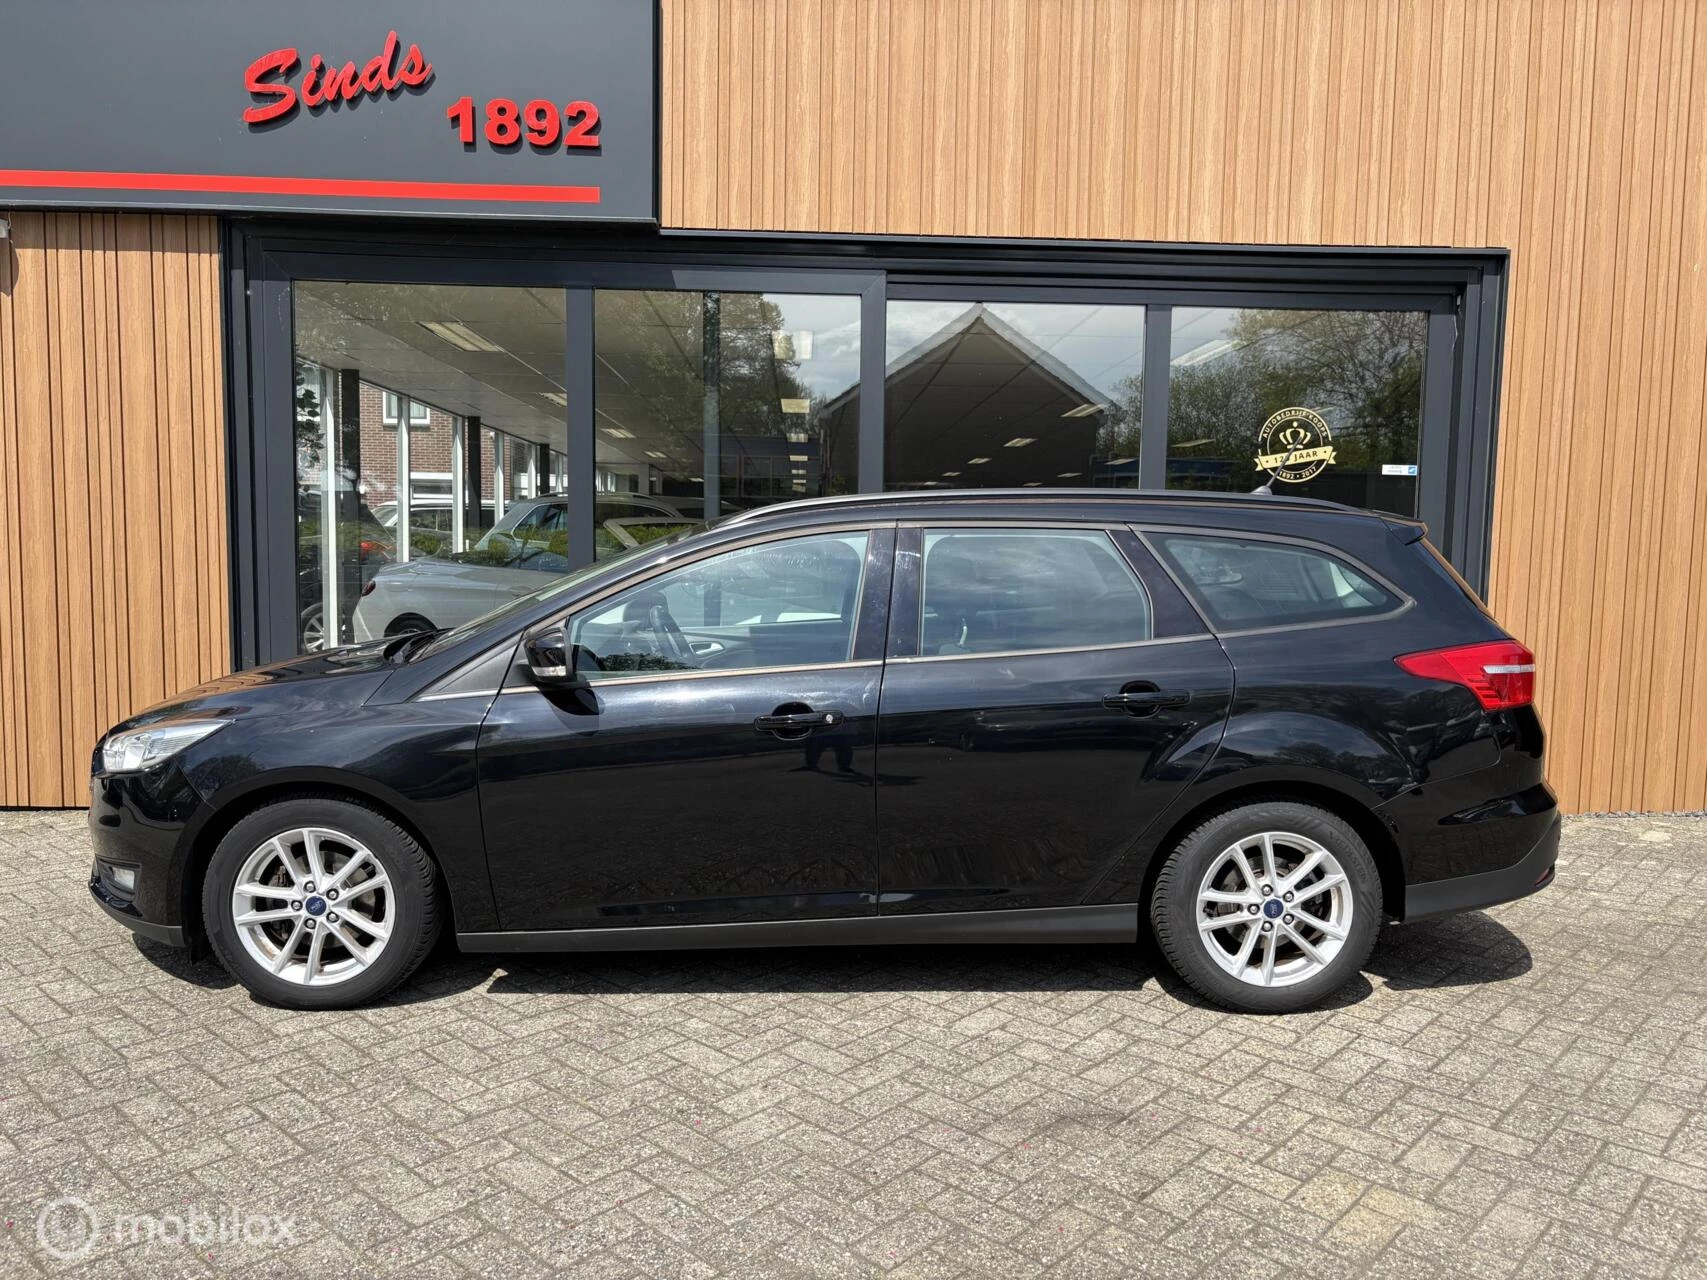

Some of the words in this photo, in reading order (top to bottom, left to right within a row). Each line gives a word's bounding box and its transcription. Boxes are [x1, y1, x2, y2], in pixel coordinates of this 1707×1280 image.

[243, 30, 433, 124] Sinds
[447, 96, 600, 147] 1892
[1262, 410, 1308, 439] AUTOBEDRIJF
[1308, 412, 1328, 438] KOOPS
[1294, 450, 1318, 462] JAAR
[1301, 466, 1317, 478] 2017
